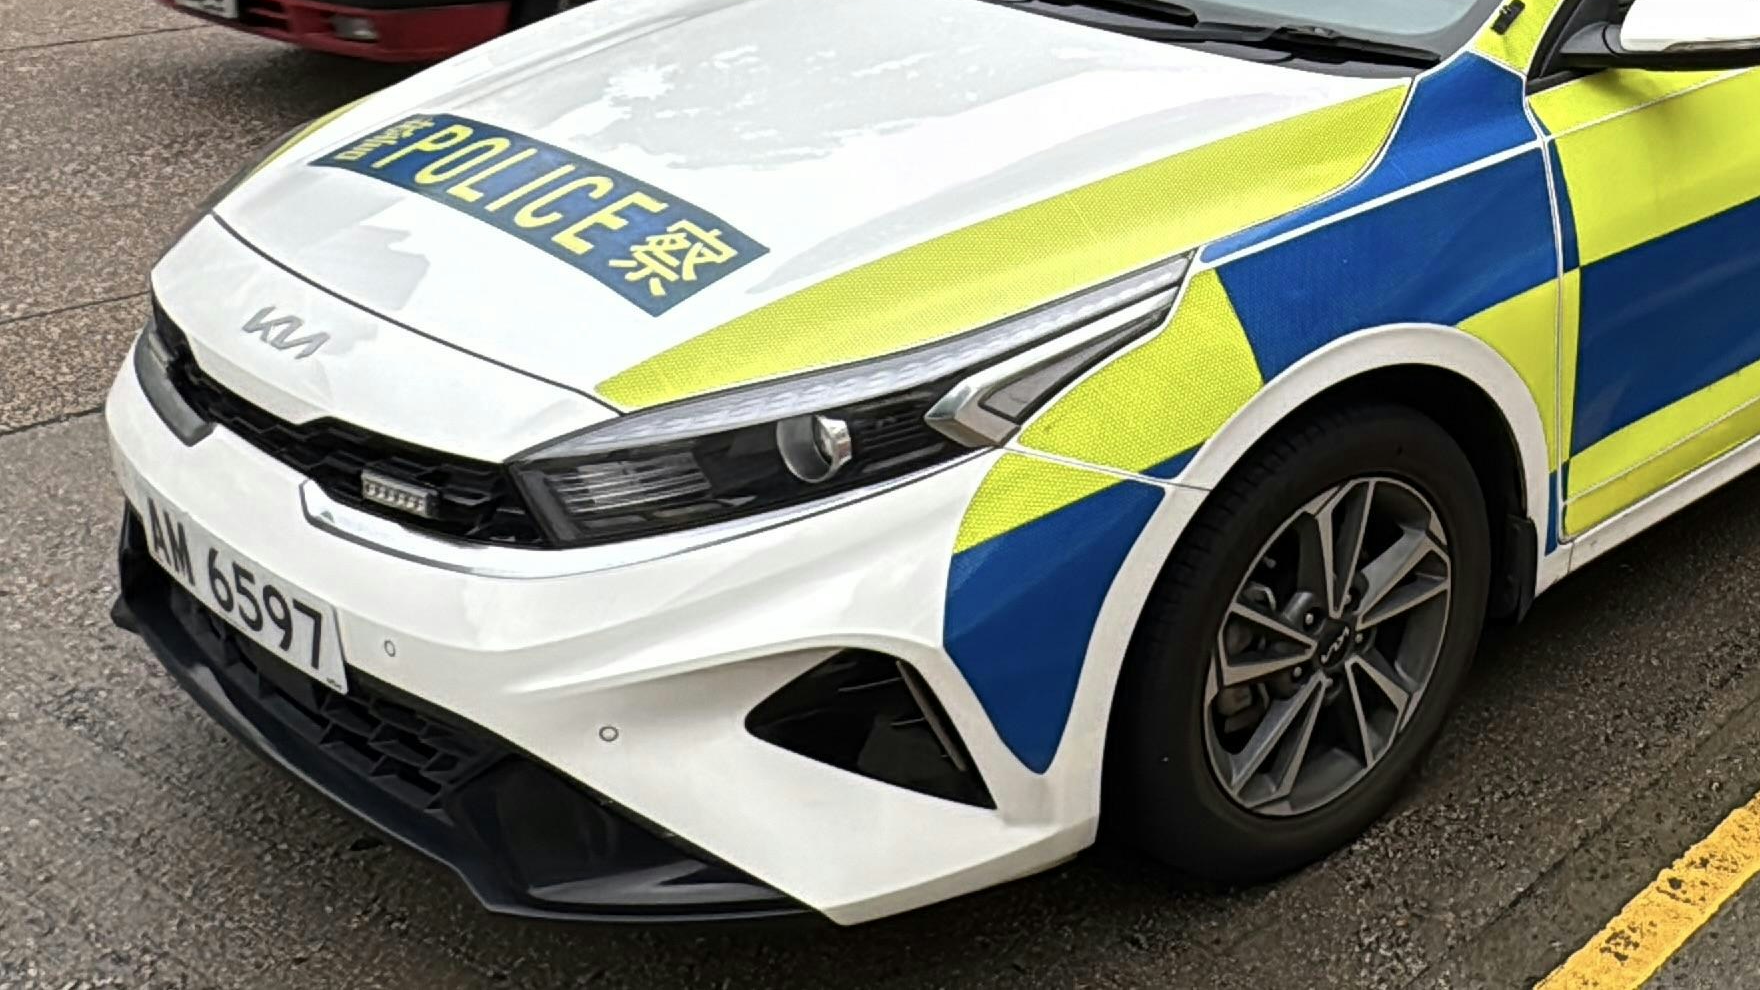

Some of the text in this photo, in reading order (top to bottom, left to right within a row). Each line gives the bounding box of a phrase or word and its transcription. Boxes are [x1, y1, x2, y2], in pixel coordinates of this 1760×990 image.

[372, 124, 668, 255] POLICE
[147, 497, 322, 671] AM 6597
